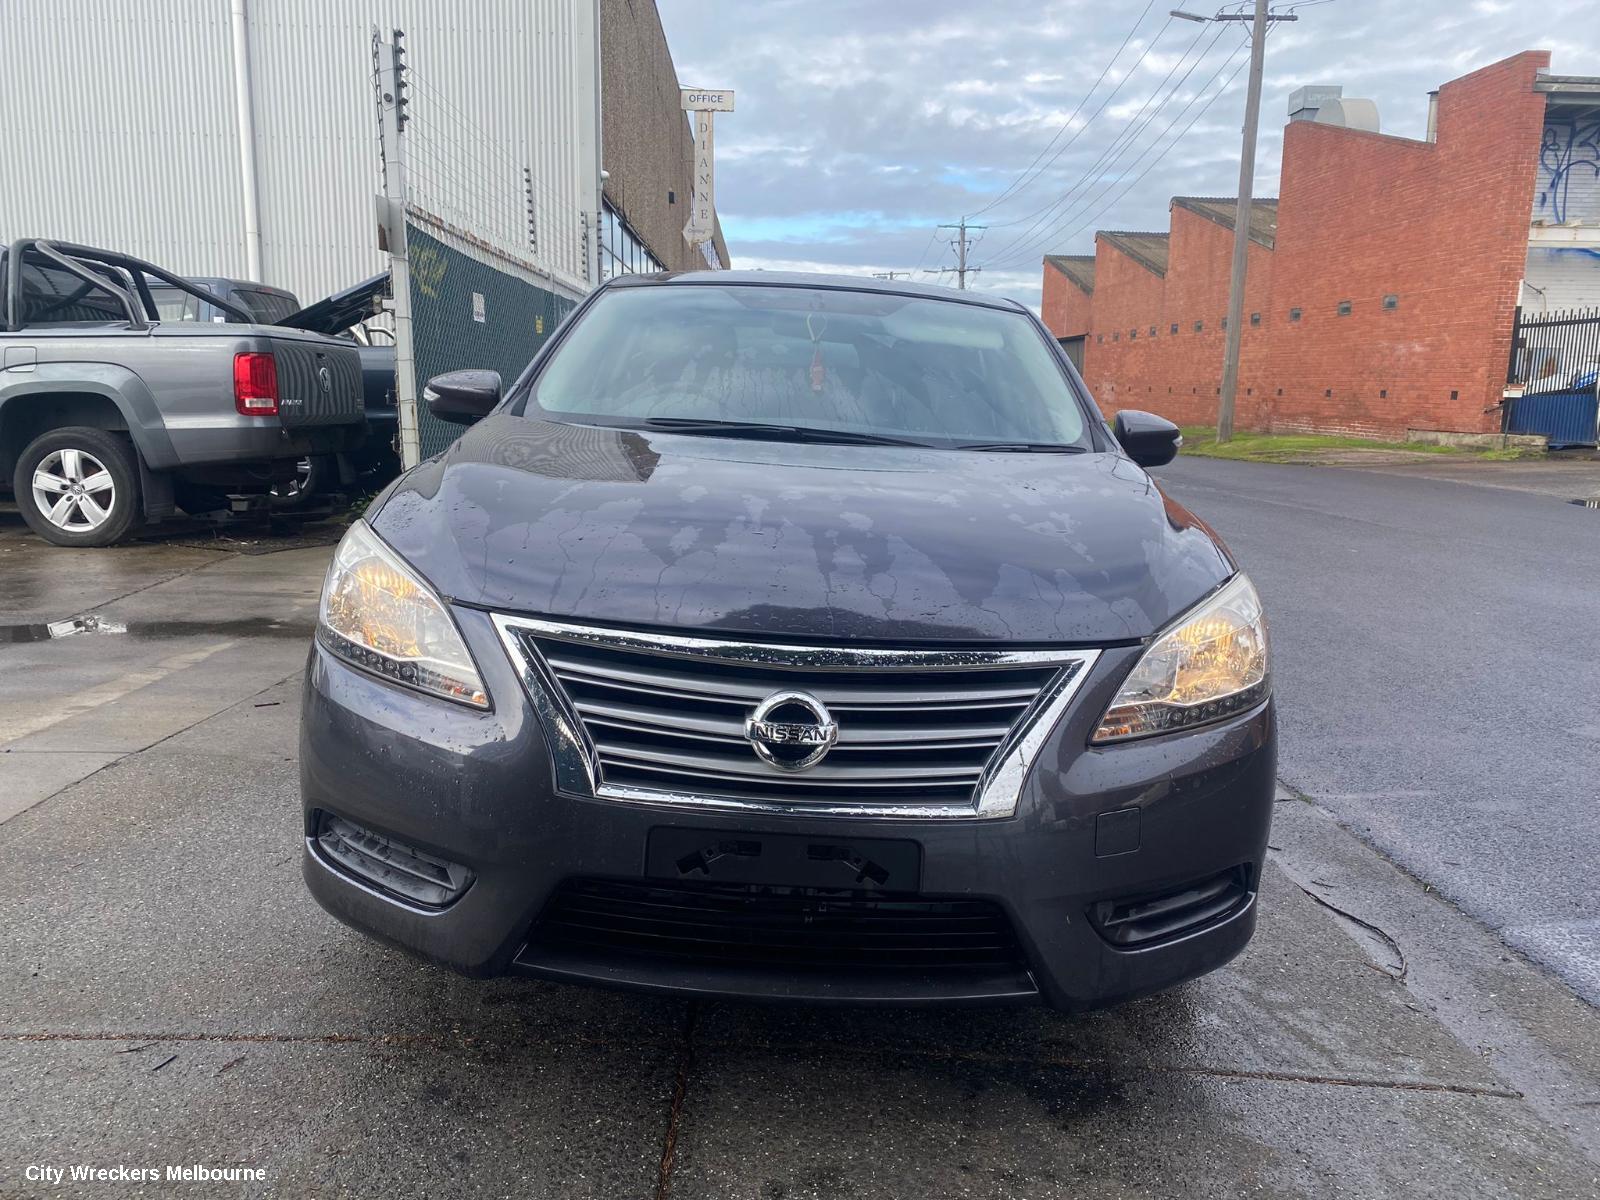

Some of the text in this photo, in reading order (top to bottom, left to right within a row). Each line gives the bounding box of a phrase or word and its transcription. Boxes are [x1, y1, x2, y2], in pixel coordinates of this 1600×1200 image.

[688, 94, 724, 104] OFFICE
[699, 122, 709, 220] DIANNE
[755, 724, 828, 742] NISSAN
